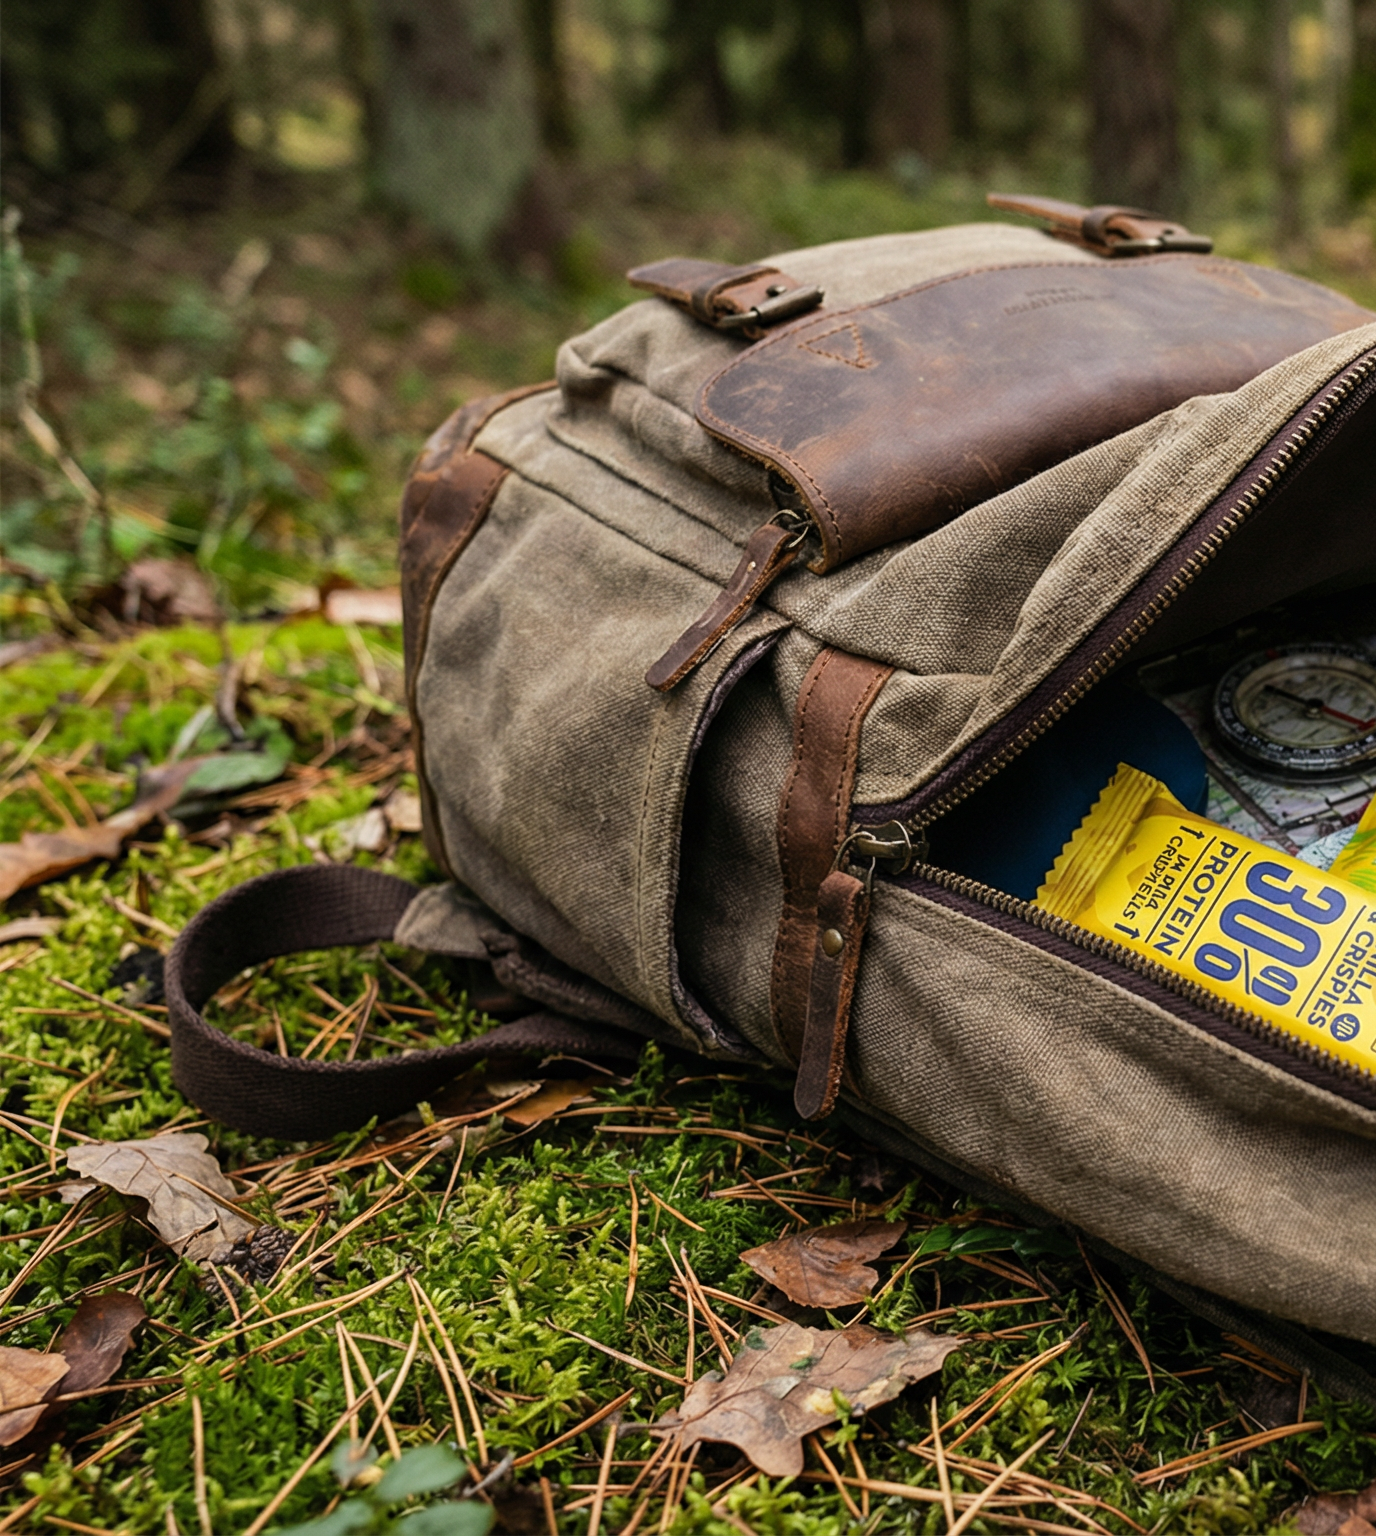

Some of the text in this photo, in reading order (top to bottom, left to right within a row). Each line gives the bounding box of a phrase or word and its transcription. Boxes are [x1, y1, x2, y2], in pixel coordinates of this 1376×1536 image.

[1152, 841, 1239, 956] PROTEIN
[1193, 861, 1347, 1006] 30%
[1307, 931, 1374, 1028] CRISPIES
